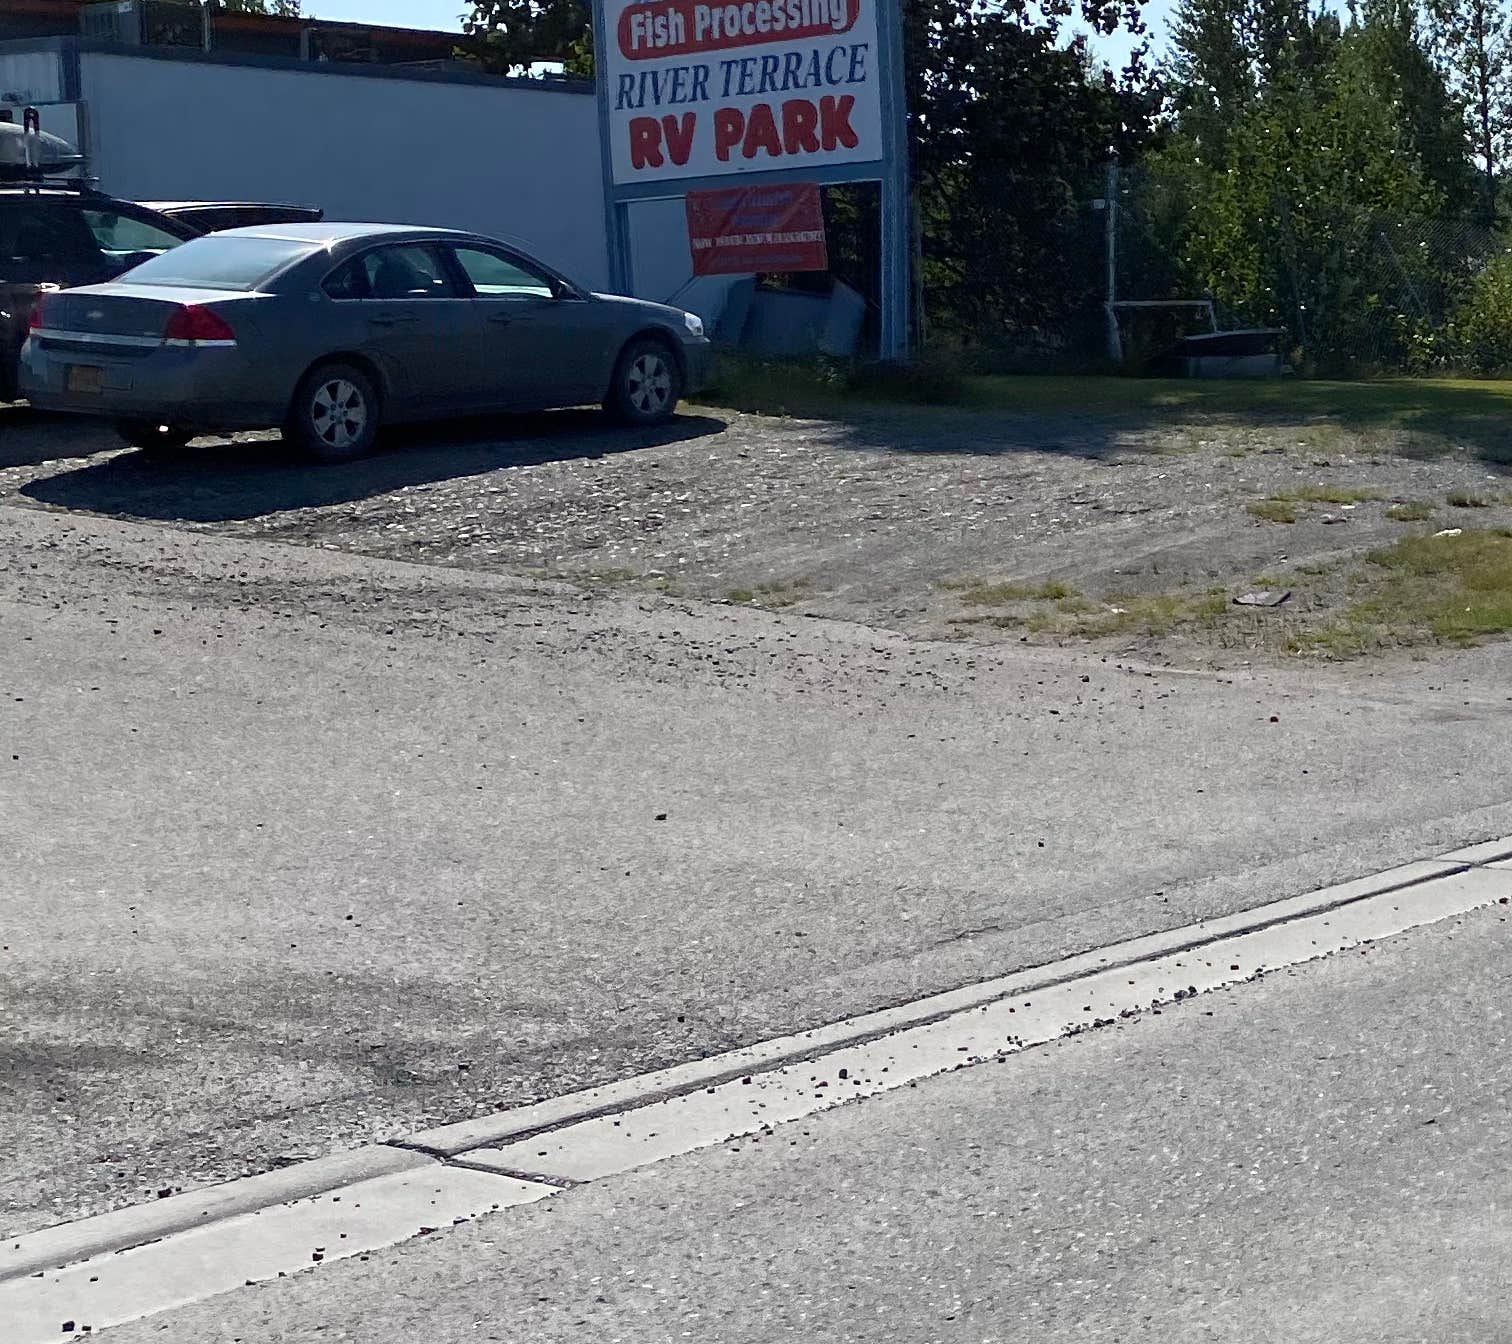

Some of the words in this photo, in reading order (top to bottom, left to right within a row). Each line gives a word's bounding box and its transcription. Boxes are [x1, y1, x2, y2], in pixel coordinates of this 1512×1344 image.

[630, 8, 685, 50] Fish
[614, 64, 710, 110] RIVER
[720, 43, 868, 98] TERRACE
[629, 112, 696, 170] RV
[713, 95, 859, 162] PARK
